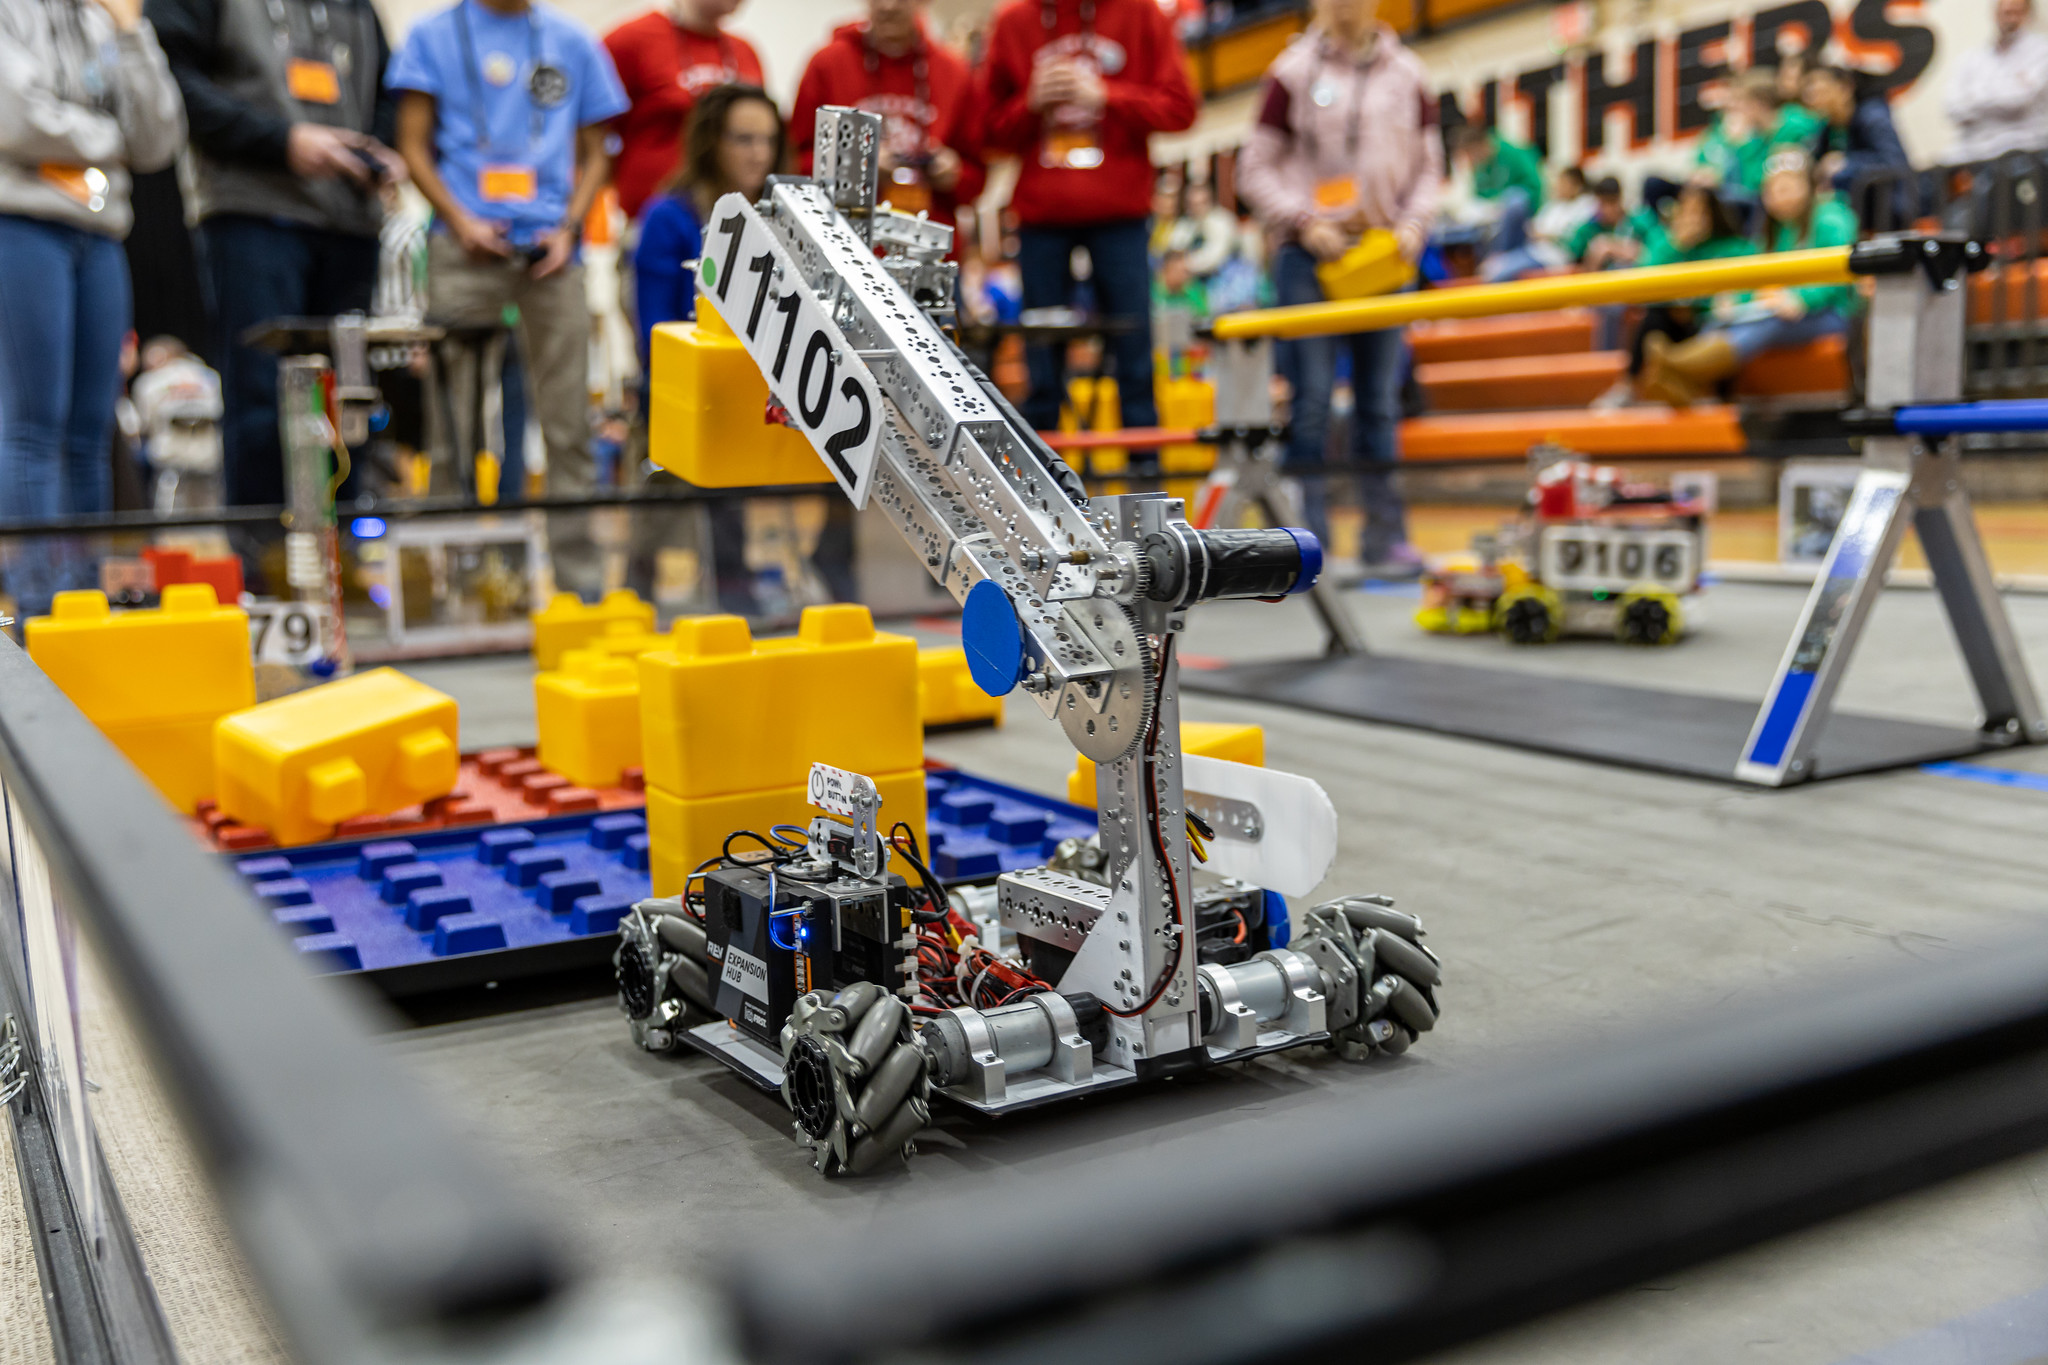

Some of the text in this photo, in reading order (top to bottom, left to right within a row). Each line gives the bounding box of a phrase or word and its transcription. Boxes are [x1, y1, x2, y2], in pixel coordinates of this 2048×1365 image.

[716, 212, 871, 490] 11102
[1558, 539, 1682, 581] 9106
[725, 966, 742, 983] HUB
[727, 952, 767, 981] EXPANSION
